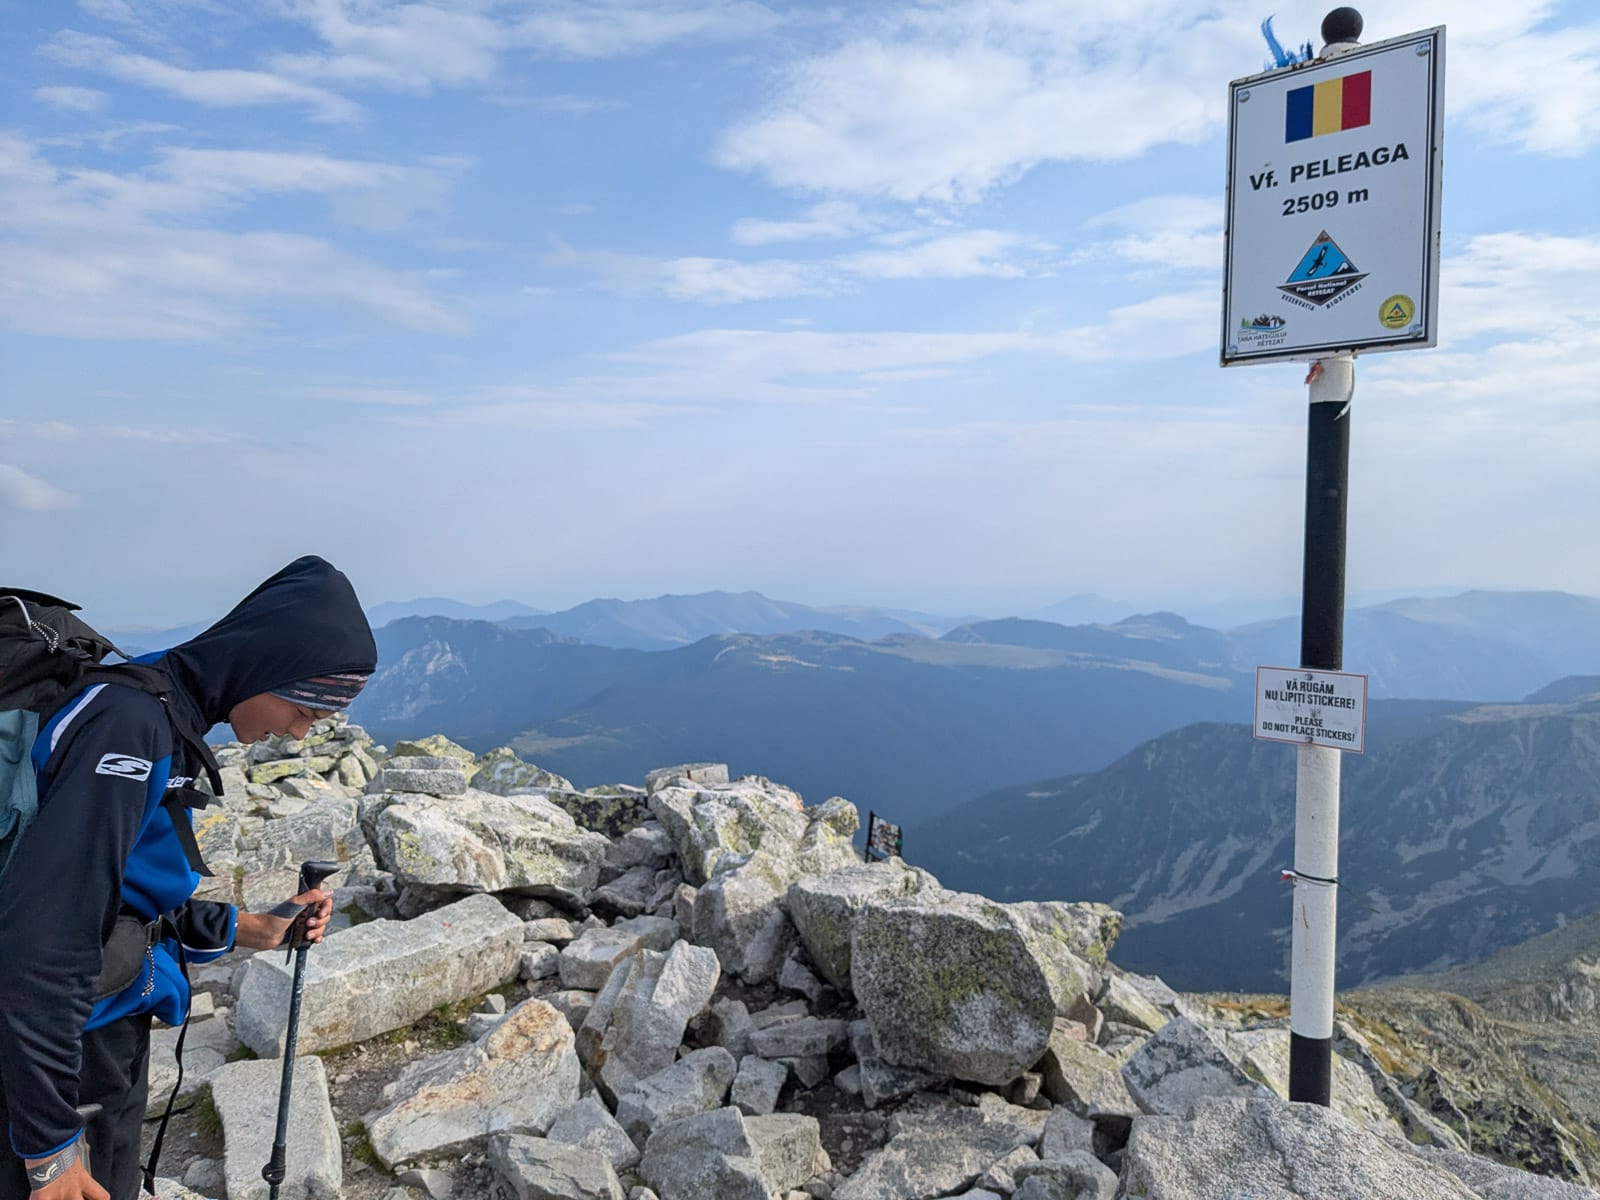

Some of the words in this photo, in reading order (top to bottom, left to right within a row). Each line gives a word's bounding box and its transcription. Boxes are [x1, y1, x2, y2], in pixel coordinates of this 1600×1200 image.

[1249, 170, 1279, 191] Vf.
[1290, 143, 1409, 183] PELEAGA
[1282, 190, 1339, 216] 2509
[1347, 188, 1369, 204] m
[1286, 678, 1298, 691] VĂ
[1300, 680, 1334, 695] RUGĂM
[1264, 689, 1278, 701] NU
[1307, 693, 1356, 710] STICKERE!
[1262, 721, 1273, 731] DO
[1274, 722, 1289, 733] NOT
[1290, 725, 1315, 737] PLACE
[1316, 728, 1355, 742] STICKERS!
[1295, 716, 1324, 728] PLEASE
